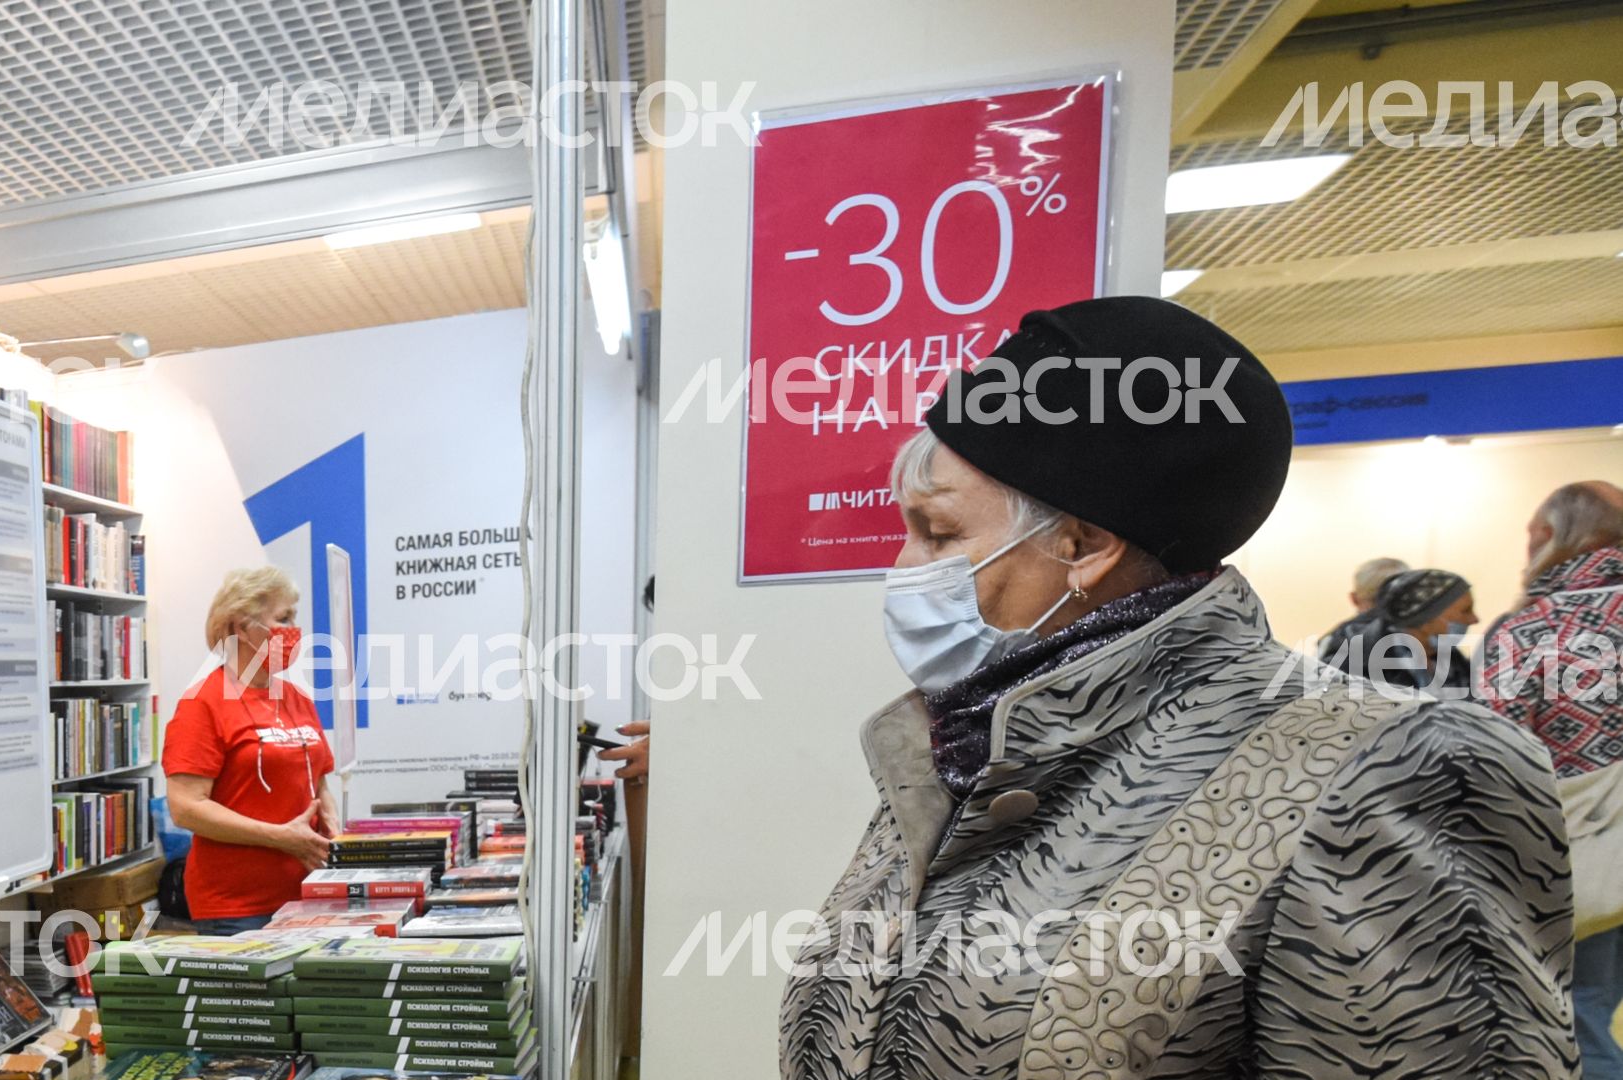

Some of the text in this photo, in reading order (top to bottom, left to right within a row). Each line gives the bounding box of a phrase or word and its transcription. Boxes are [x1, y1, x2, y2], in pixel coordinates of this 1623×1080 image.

[813, 396, 888, 435] НА
[395, 532, 453, 552] САМАЯ
[808, 537, 833, 546] Цена
[395, 551, 523, 576] КНИЖНАЯ СЕТЬ
[396, 578, 476, 600] В РОССИИ
[180, 960, 250, 973] ПСИХОЛОГИЯ СТРОЙНЫХ
[407, 965, 489, 976] ПСИХОЛОГИЯ СТРОЙНЫХ
[194, 980, 267, 991] ПСИХОЛОГИЯ СТРОЙНЫХ
[401, 984, 482, 994] ПСИХОЛОГИЯ СТРОЙНЫХ
[201, 996, 275, 1008] ПСИХОЛОГИЯ СТРОЙНЫХ
[407, 1003, 489, 1014] ПСИХОЛОГИЯ СТРОЙНЫХ
[198, 1015, 271, 1027] ПСИХОЛОГИЯ СТРОЙНЫХ
[407, 1021, 489, 1032] ПСИХОЛОГИЯ СТРОЙНЫХ
[202, 1032, 276, 1044] ПСИХОЛОГИЯ СТРОЙНЫХ
[415, 1039, 497, 1050] ПСИХОЛОГИЯ СТРОЙНЫХ
[411, 1056, 494, 1068] ПСИХОЛОГИЯ СТРОЙНЫХ
